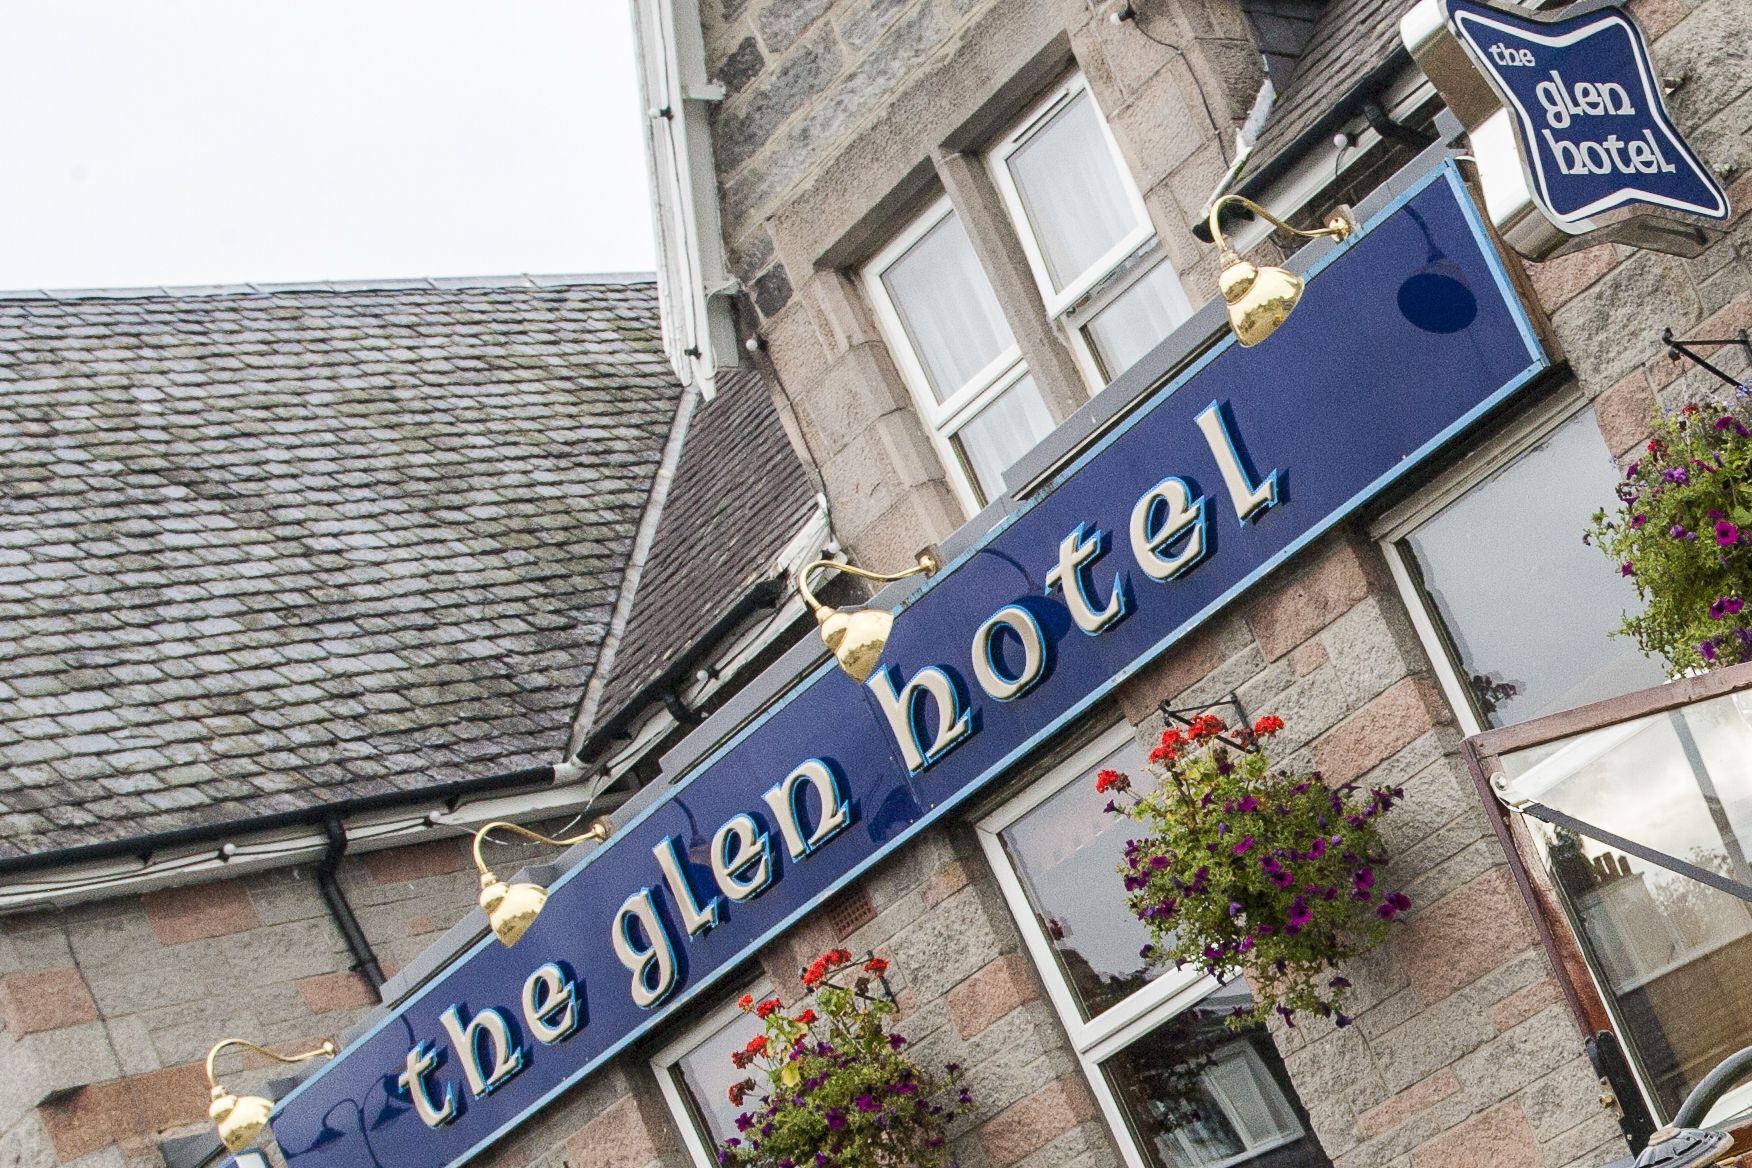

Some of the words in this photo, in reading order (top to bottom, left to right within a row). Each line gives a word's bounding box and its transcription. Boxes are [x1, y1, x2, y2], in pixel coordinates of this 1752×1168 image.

[1488, 43, 1535, 67] the
[1535, 70, 1635, 129] glen
[1541, 129, 1676, 175] hotel
[398, 960, 577, 1130] the
[611, 756, 850, 1010] glen
[864, 400, 1279, 777] hotel
